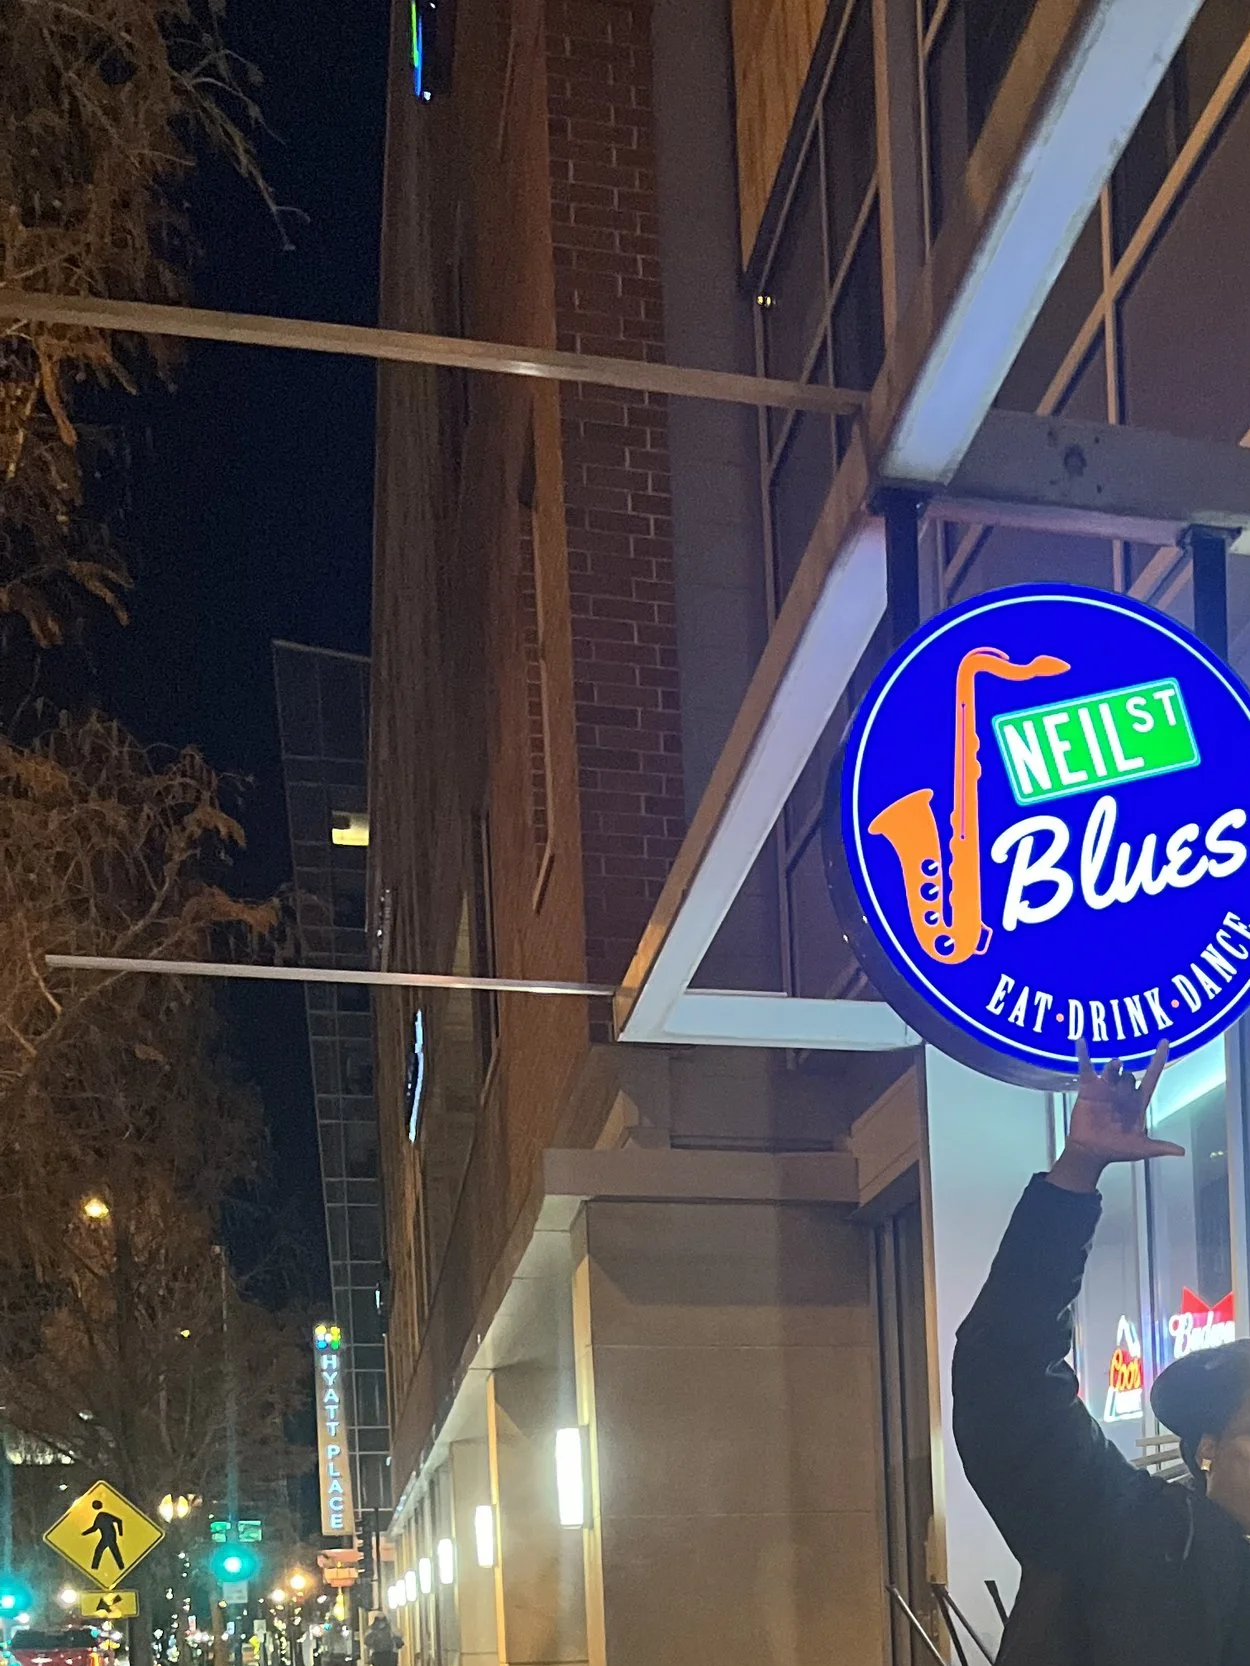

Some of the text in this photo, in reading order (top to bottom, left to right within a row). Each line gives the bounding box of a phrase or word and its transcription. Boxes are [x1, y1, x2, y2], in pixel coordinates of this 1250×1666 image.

[1003, 690, 1178, 794] NEIL ST
[991, 795, 1248, 932] Blues
[986, 973, 1052, 1034] EAT
[1067, 988, 1174, 1042] DRINK
[322, 1354, 344, 1529] HYATT PLACE
